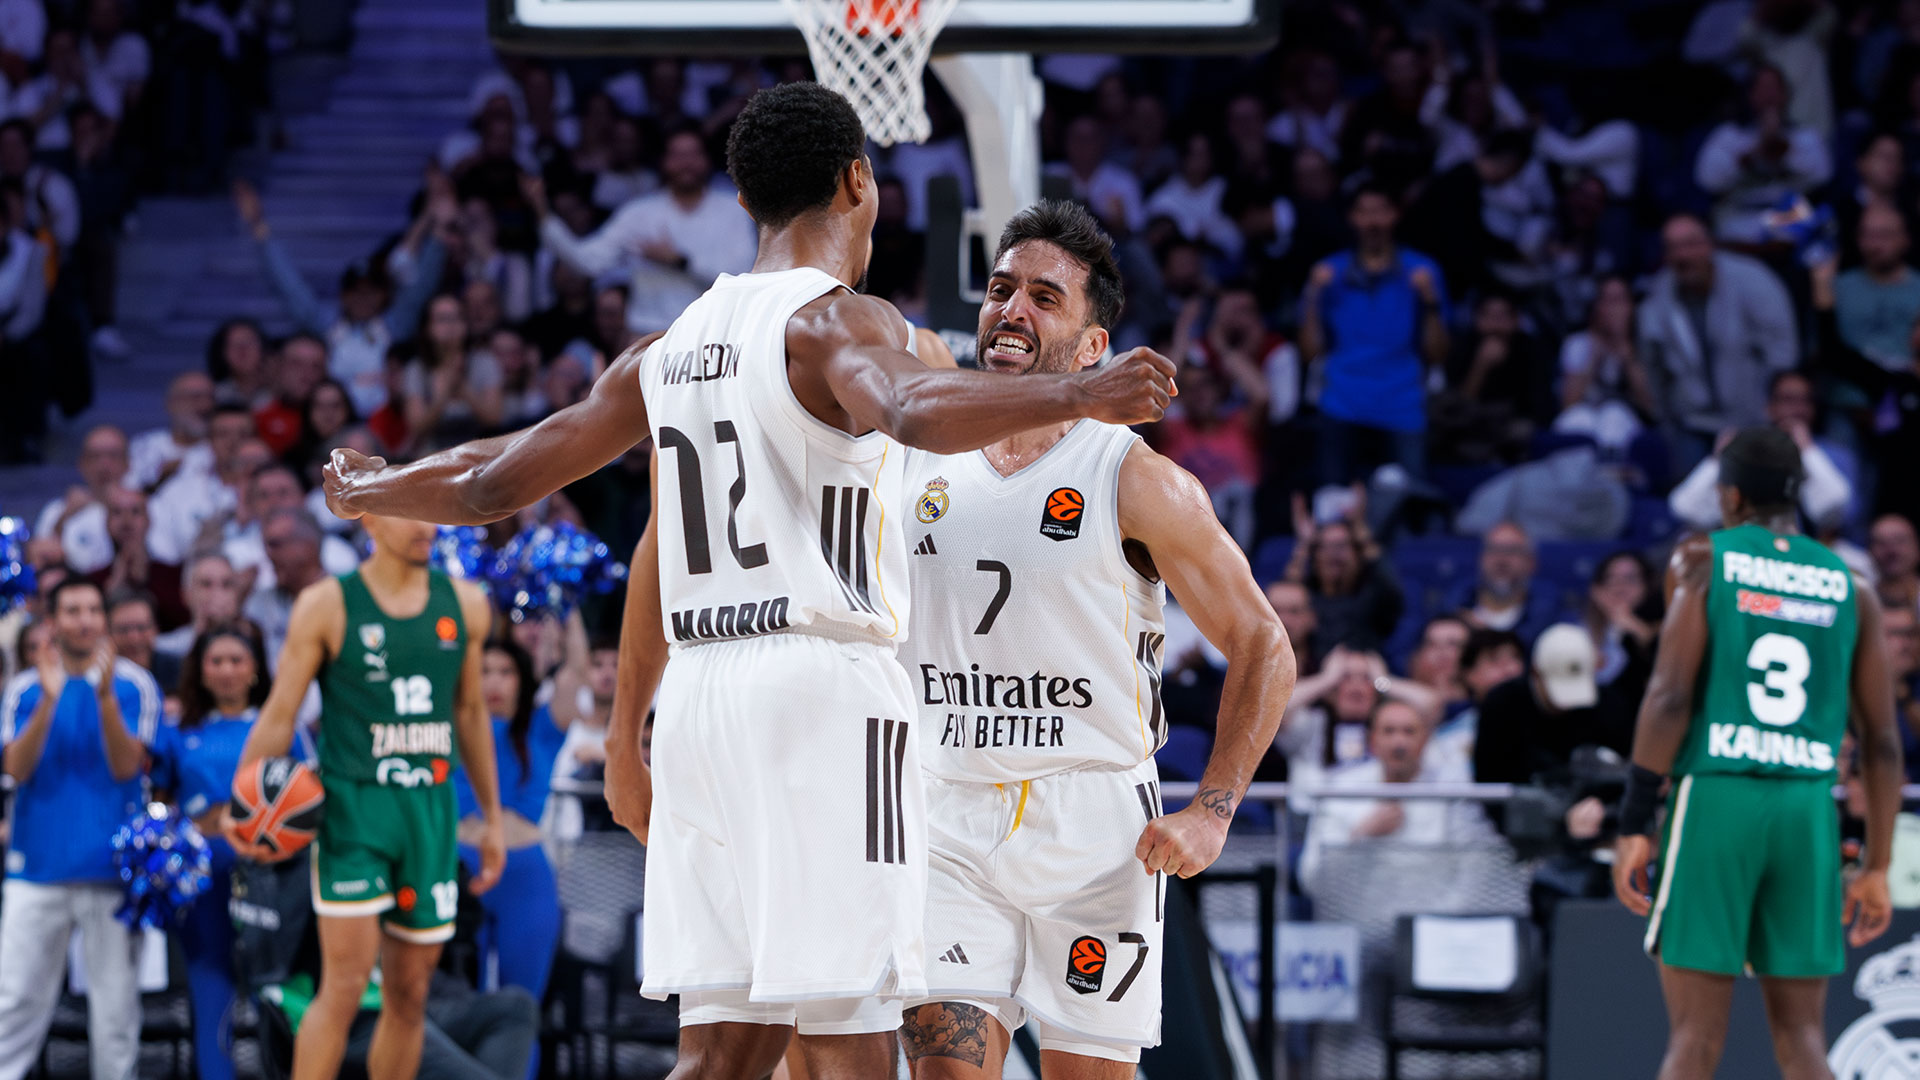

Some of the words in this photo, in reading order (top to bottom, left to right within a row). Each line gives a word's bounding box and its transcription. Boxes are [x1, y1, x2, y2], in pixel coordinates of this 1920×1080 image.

[659, 420, 769, 575] 12
[974, 559, 1012, 635] 7
[1723, 551, 1848, 602] FRANCISCO
[671, 597, 790, 641] MADRID
[390, 674, 433, 715] 12
[920, 663, 1093, 709] Emirates
[1746, 632, 1811, 726] 3
[975, 715, 1064, 749] BETTER
[1106, 932, 1149, 1002] 7
